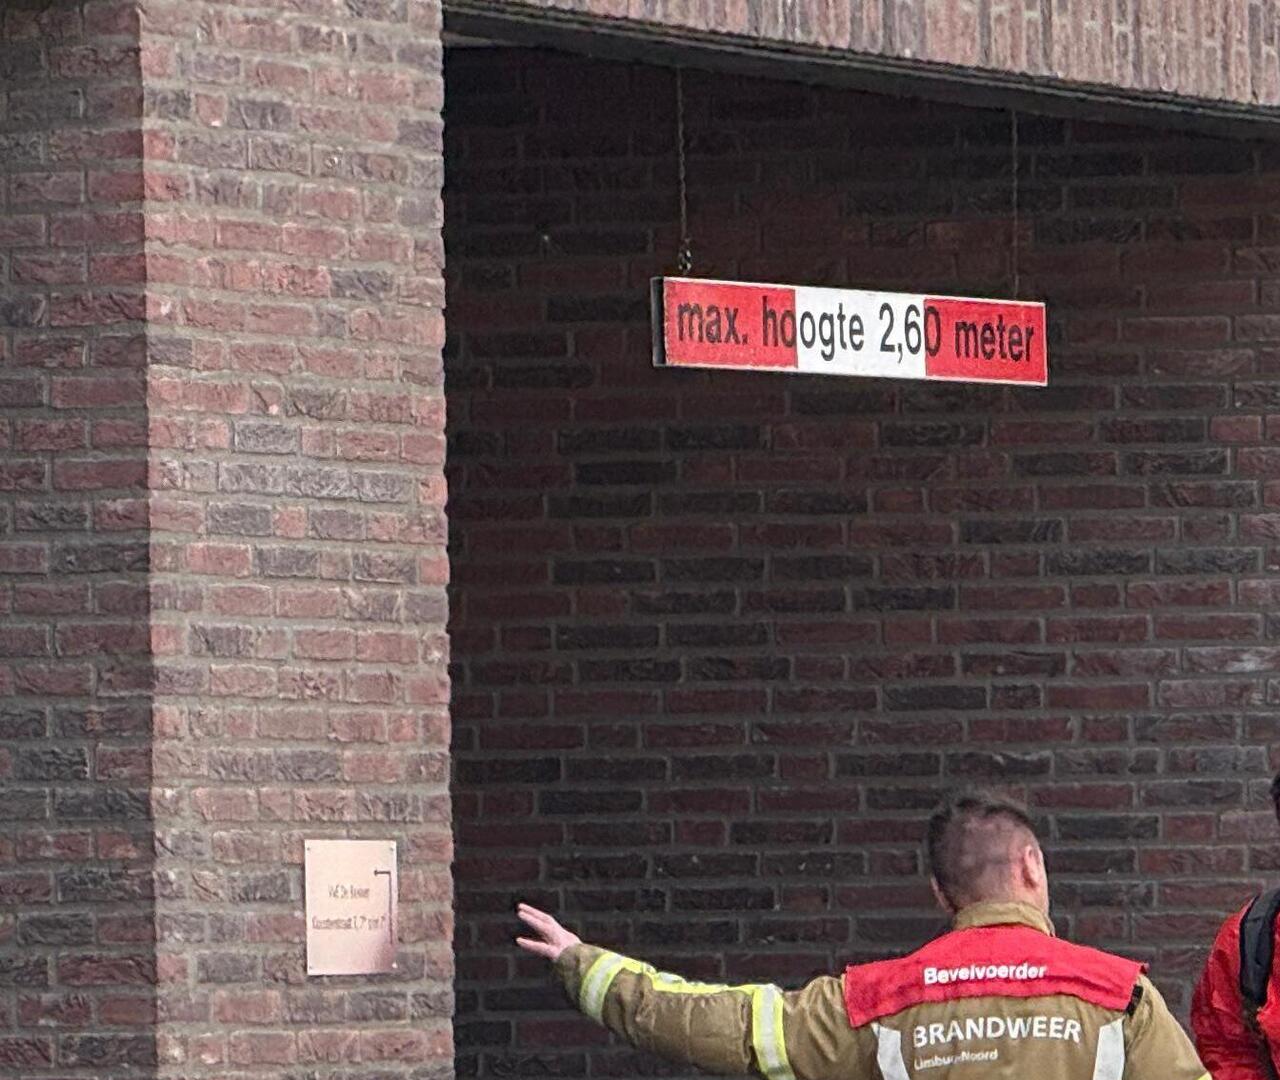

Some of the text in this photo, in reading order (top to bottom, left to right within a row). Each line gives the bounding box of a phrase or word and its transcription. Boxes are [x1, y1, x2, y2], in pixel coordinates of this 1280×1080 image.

[677, 295, 1035, 364] max. hoogte 2,60 meter
[923, 962, 1048, 986] Bevelvoerder
[912, 1015, 1083, 1049] BRANDWEER
